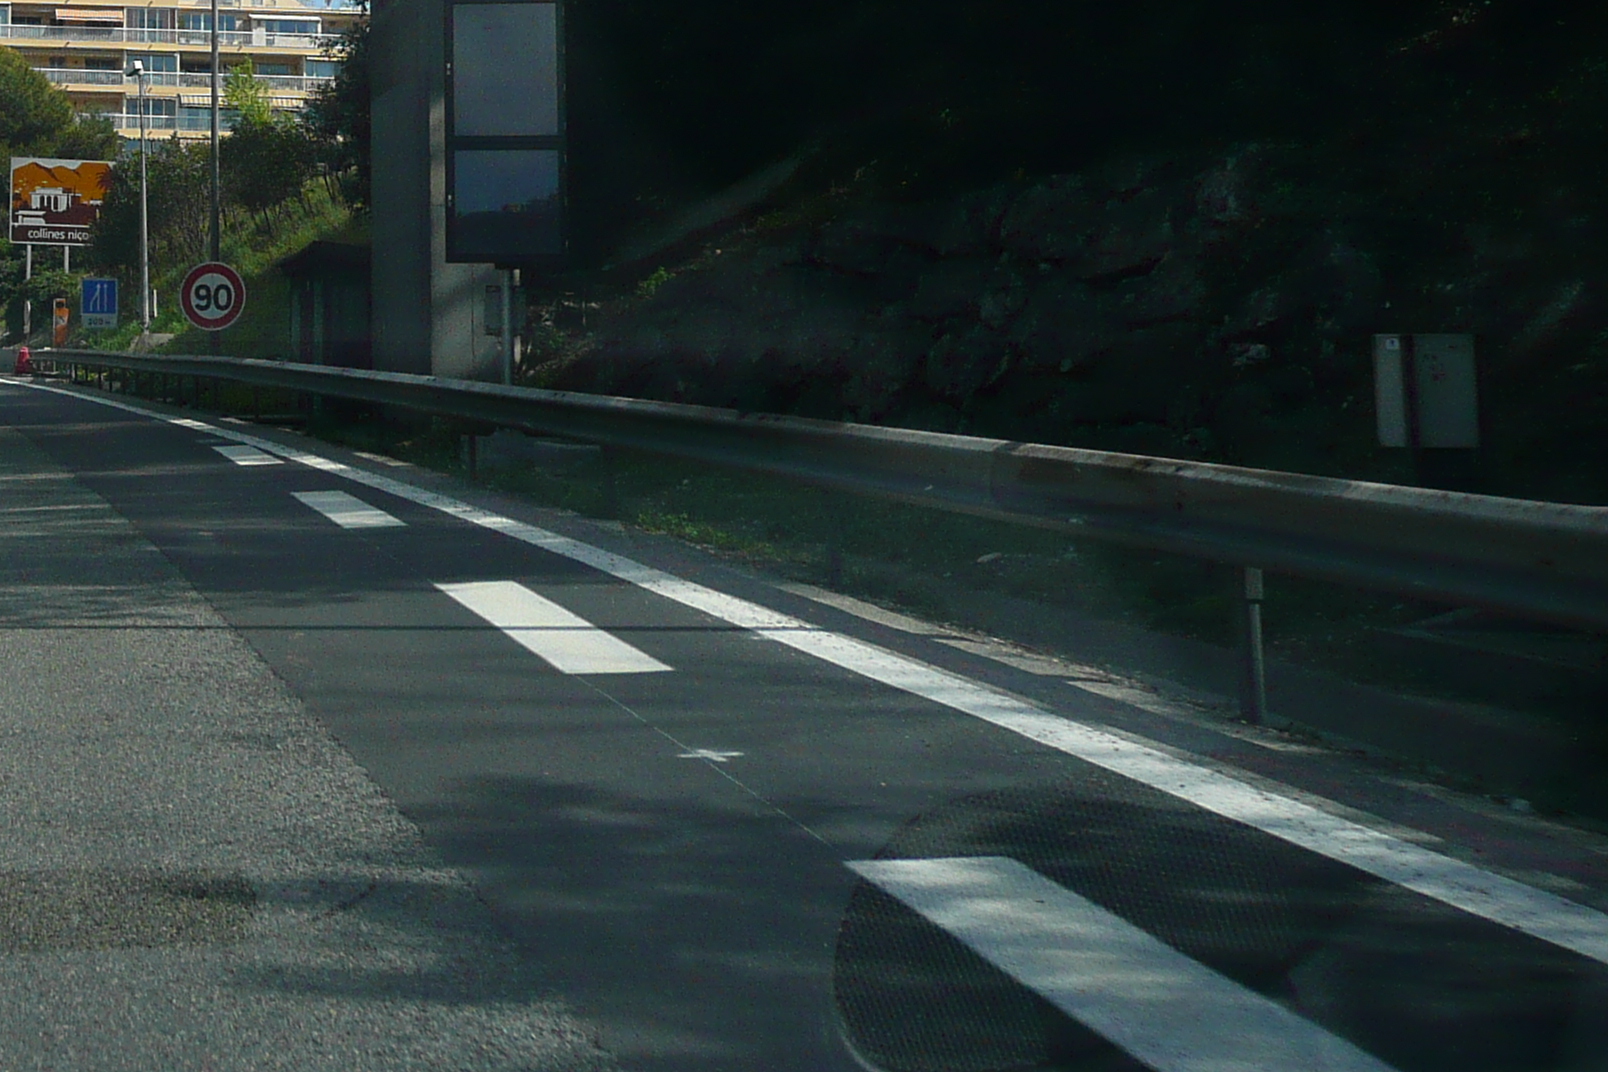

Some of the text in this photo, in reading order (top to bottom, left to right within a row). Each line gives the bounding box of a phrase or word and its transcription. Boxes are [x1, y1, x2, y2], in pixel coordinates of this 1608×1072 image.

[27, 228, 90, 242] collines niço
[194, 283, 232, 311] 90
